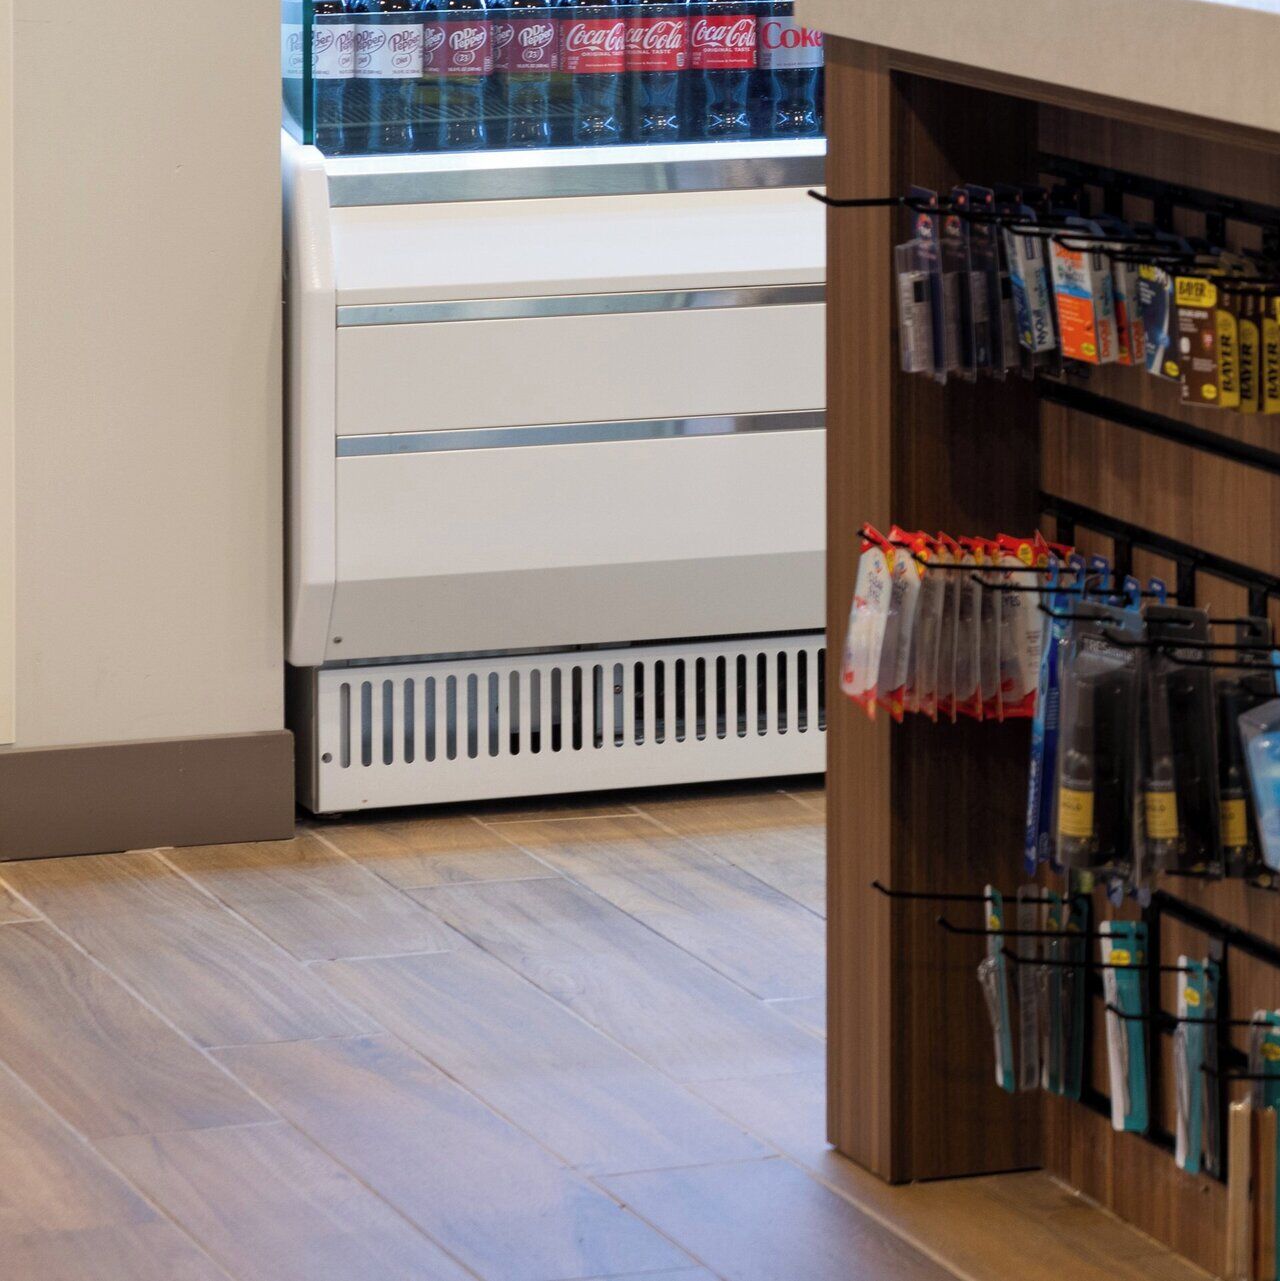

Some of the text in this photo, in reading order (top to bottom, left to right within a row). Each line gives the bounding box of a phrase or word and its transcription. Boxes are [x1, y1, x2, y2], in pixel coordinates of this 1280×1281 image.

[450, 31, 486, 52] Pepper
[518, 30, 554, 50] Pepper
[760, 21, 823, 49] Coke
[1220, 334, 1232, 393] BAYER
[1240, 343, 1253, 401] BAYER
[1267, 342, 1279, 400] BAYER
